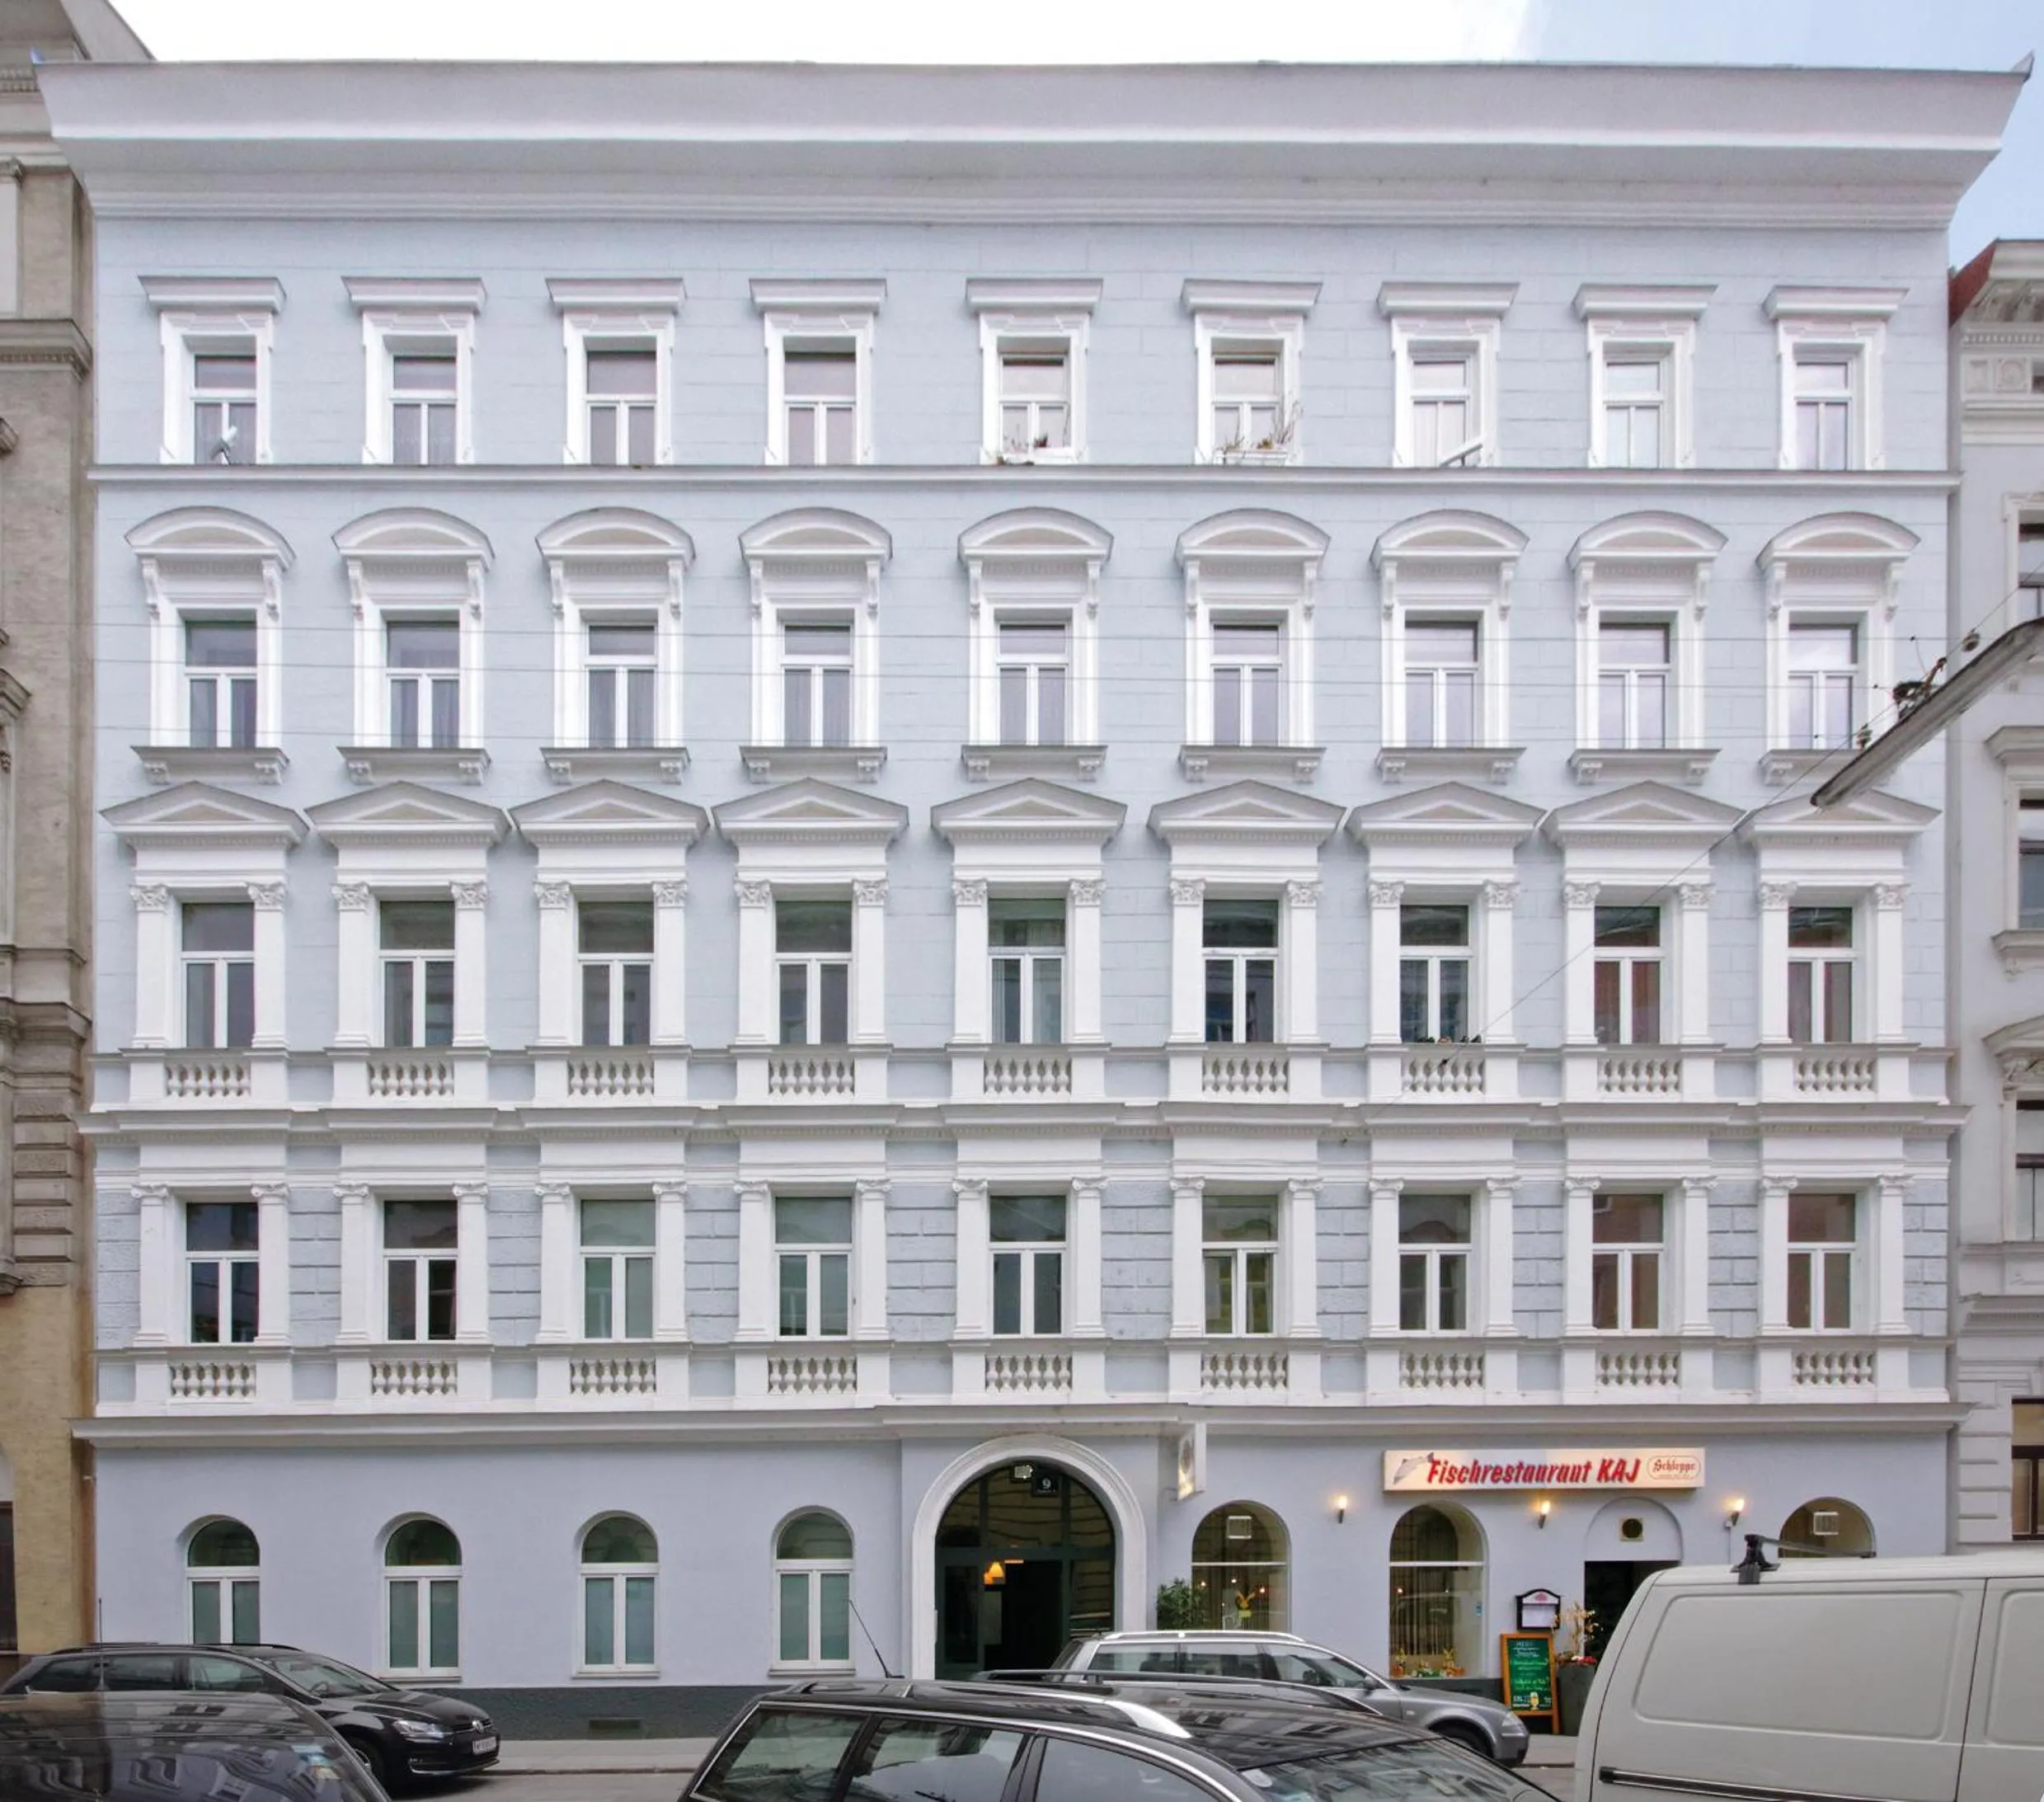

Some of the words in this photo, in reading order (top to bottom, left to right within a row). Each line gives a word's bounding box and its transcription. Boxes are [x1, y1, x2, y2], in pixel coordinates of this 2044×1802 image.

[1426, 1458, 1592, 1484] Fischrestaurant
[1596, 1458, 1641, 1483] KAJ
[1042, 1478, 1051, 1489] 9
